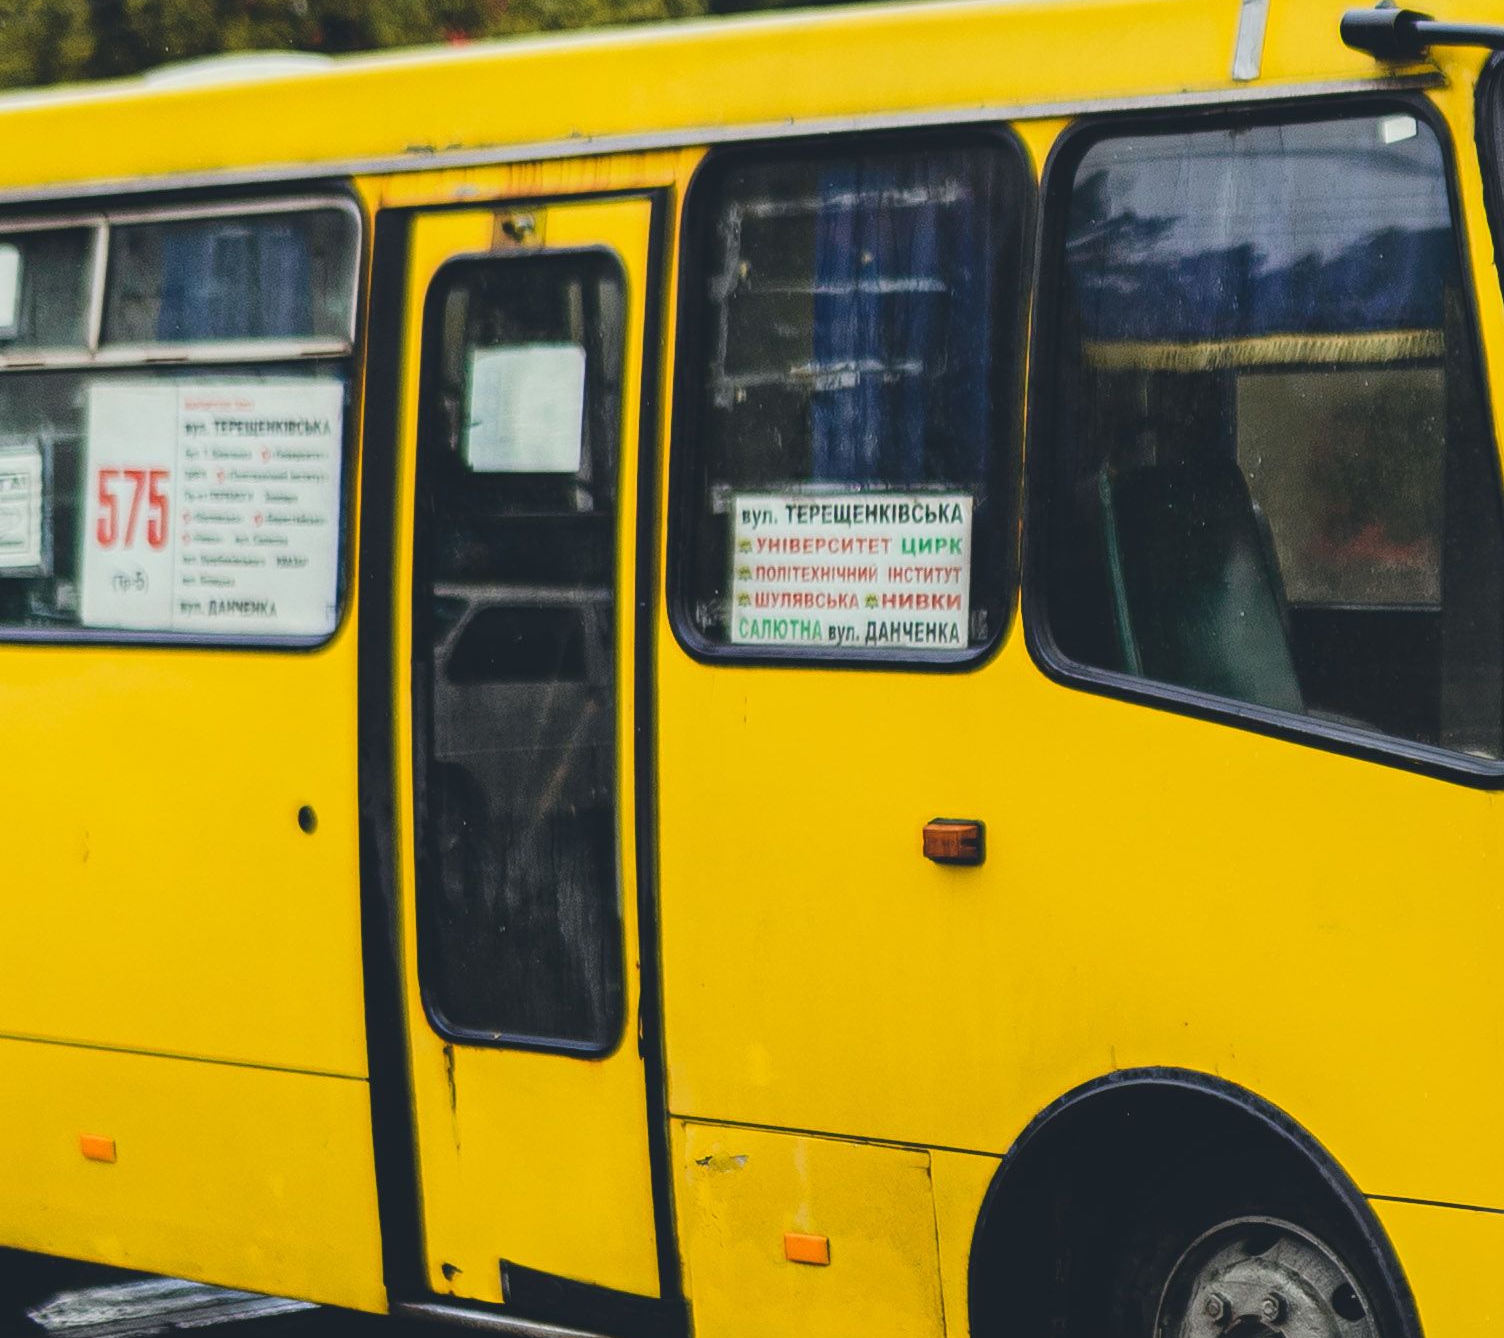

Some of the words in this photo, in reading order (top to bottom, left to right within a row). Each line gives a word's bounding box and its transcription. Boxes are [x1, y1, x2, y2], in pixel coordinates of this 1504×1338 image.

[98, 469, 170, 551] 575
[742, 509, 777, 529] вул.
[785, 503, 964, 529] ТЕРЕЩЕНКІВСЬКА
[756, 536, 892, 554] УНІВЕРСИТЕТ
[901, 537, 963, 557] ЦИРК
[755, 564, 878, 583] ПОЛІТЕХНІЧНИЙ
[888, 566, 962, 584] ІНСТИТУТ
[754, 591, 860, 610] ШУЛЯВСЬКА
[881, 593, 962, 611] НИВКИ
[739, 617, 822, 641] САЛЮТНА
[828, 623, 860, 646] вул.
[865, 620, 960, 646] ДАНЧЕНКА
